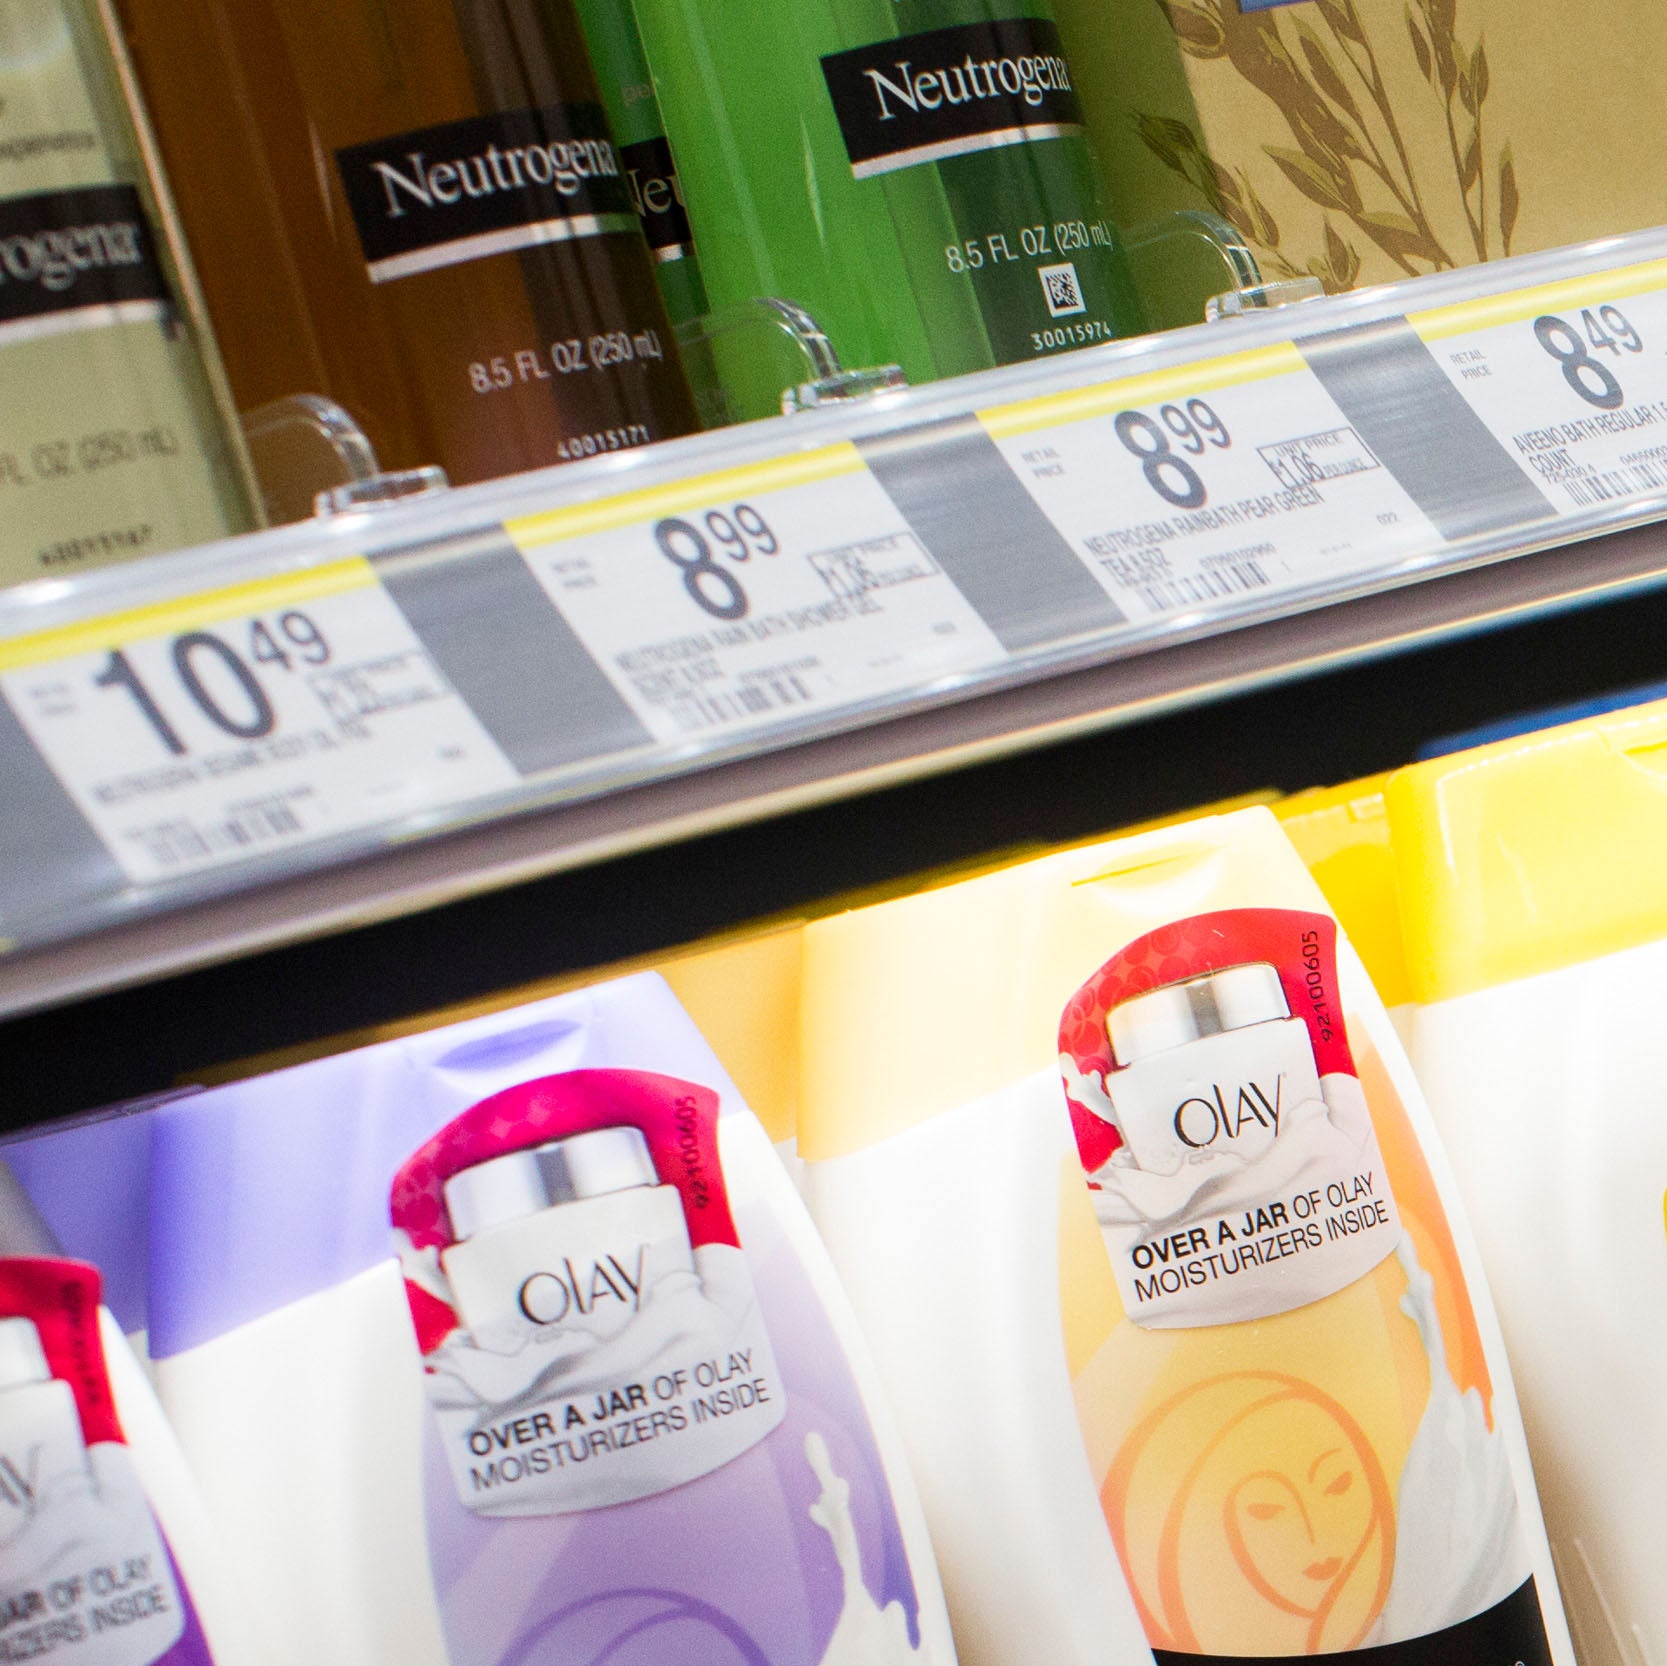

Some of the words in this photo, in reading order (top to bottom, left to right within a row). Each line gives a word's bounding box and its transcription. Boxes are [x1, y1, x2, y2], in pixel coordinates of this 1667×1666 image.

[865, 46, 1070, 121] Neutrogena
[370, 137, 619, 217] Neutrogena
[1031, 320, 1112, 351] 30015974
[1512, 426, 1566, 455] AVEENO
[1566, 418, 1597, 443] BATH
[1597, 404, 1653, 436] REGULAR
[1083, 522, 1177, 557] NEUTROGENA
[1240, 495, 1275, 520] PEAR
[1276, 485, 1325, 511] GREEN
[1131, 1230, 1210, 1269] OVER
[1218, 1221, 1236, 1246] A
[1241, 1202, 1290, 1238] JAR
[1292, 1191, 1322, 1218] OF
[1327, 1171, 1375, 1204] OLAY
[1134, 1223, 1323, 1303] MOISTURIZERS
[1327, 1199, 1391, 1241] INSIDE
[469, 1413, 554, 1456] OVER
[564, 1405, 585, 1429] A
[593, 1384, 648, 1420] JAR
[653, 1372, 687, 1400] OF
[694, 1349, 755, 1388] OLAY
[470, 1405, 687, 1491] MOISTURIZERS
[696, 1379, 771, 1423] INSIDE
